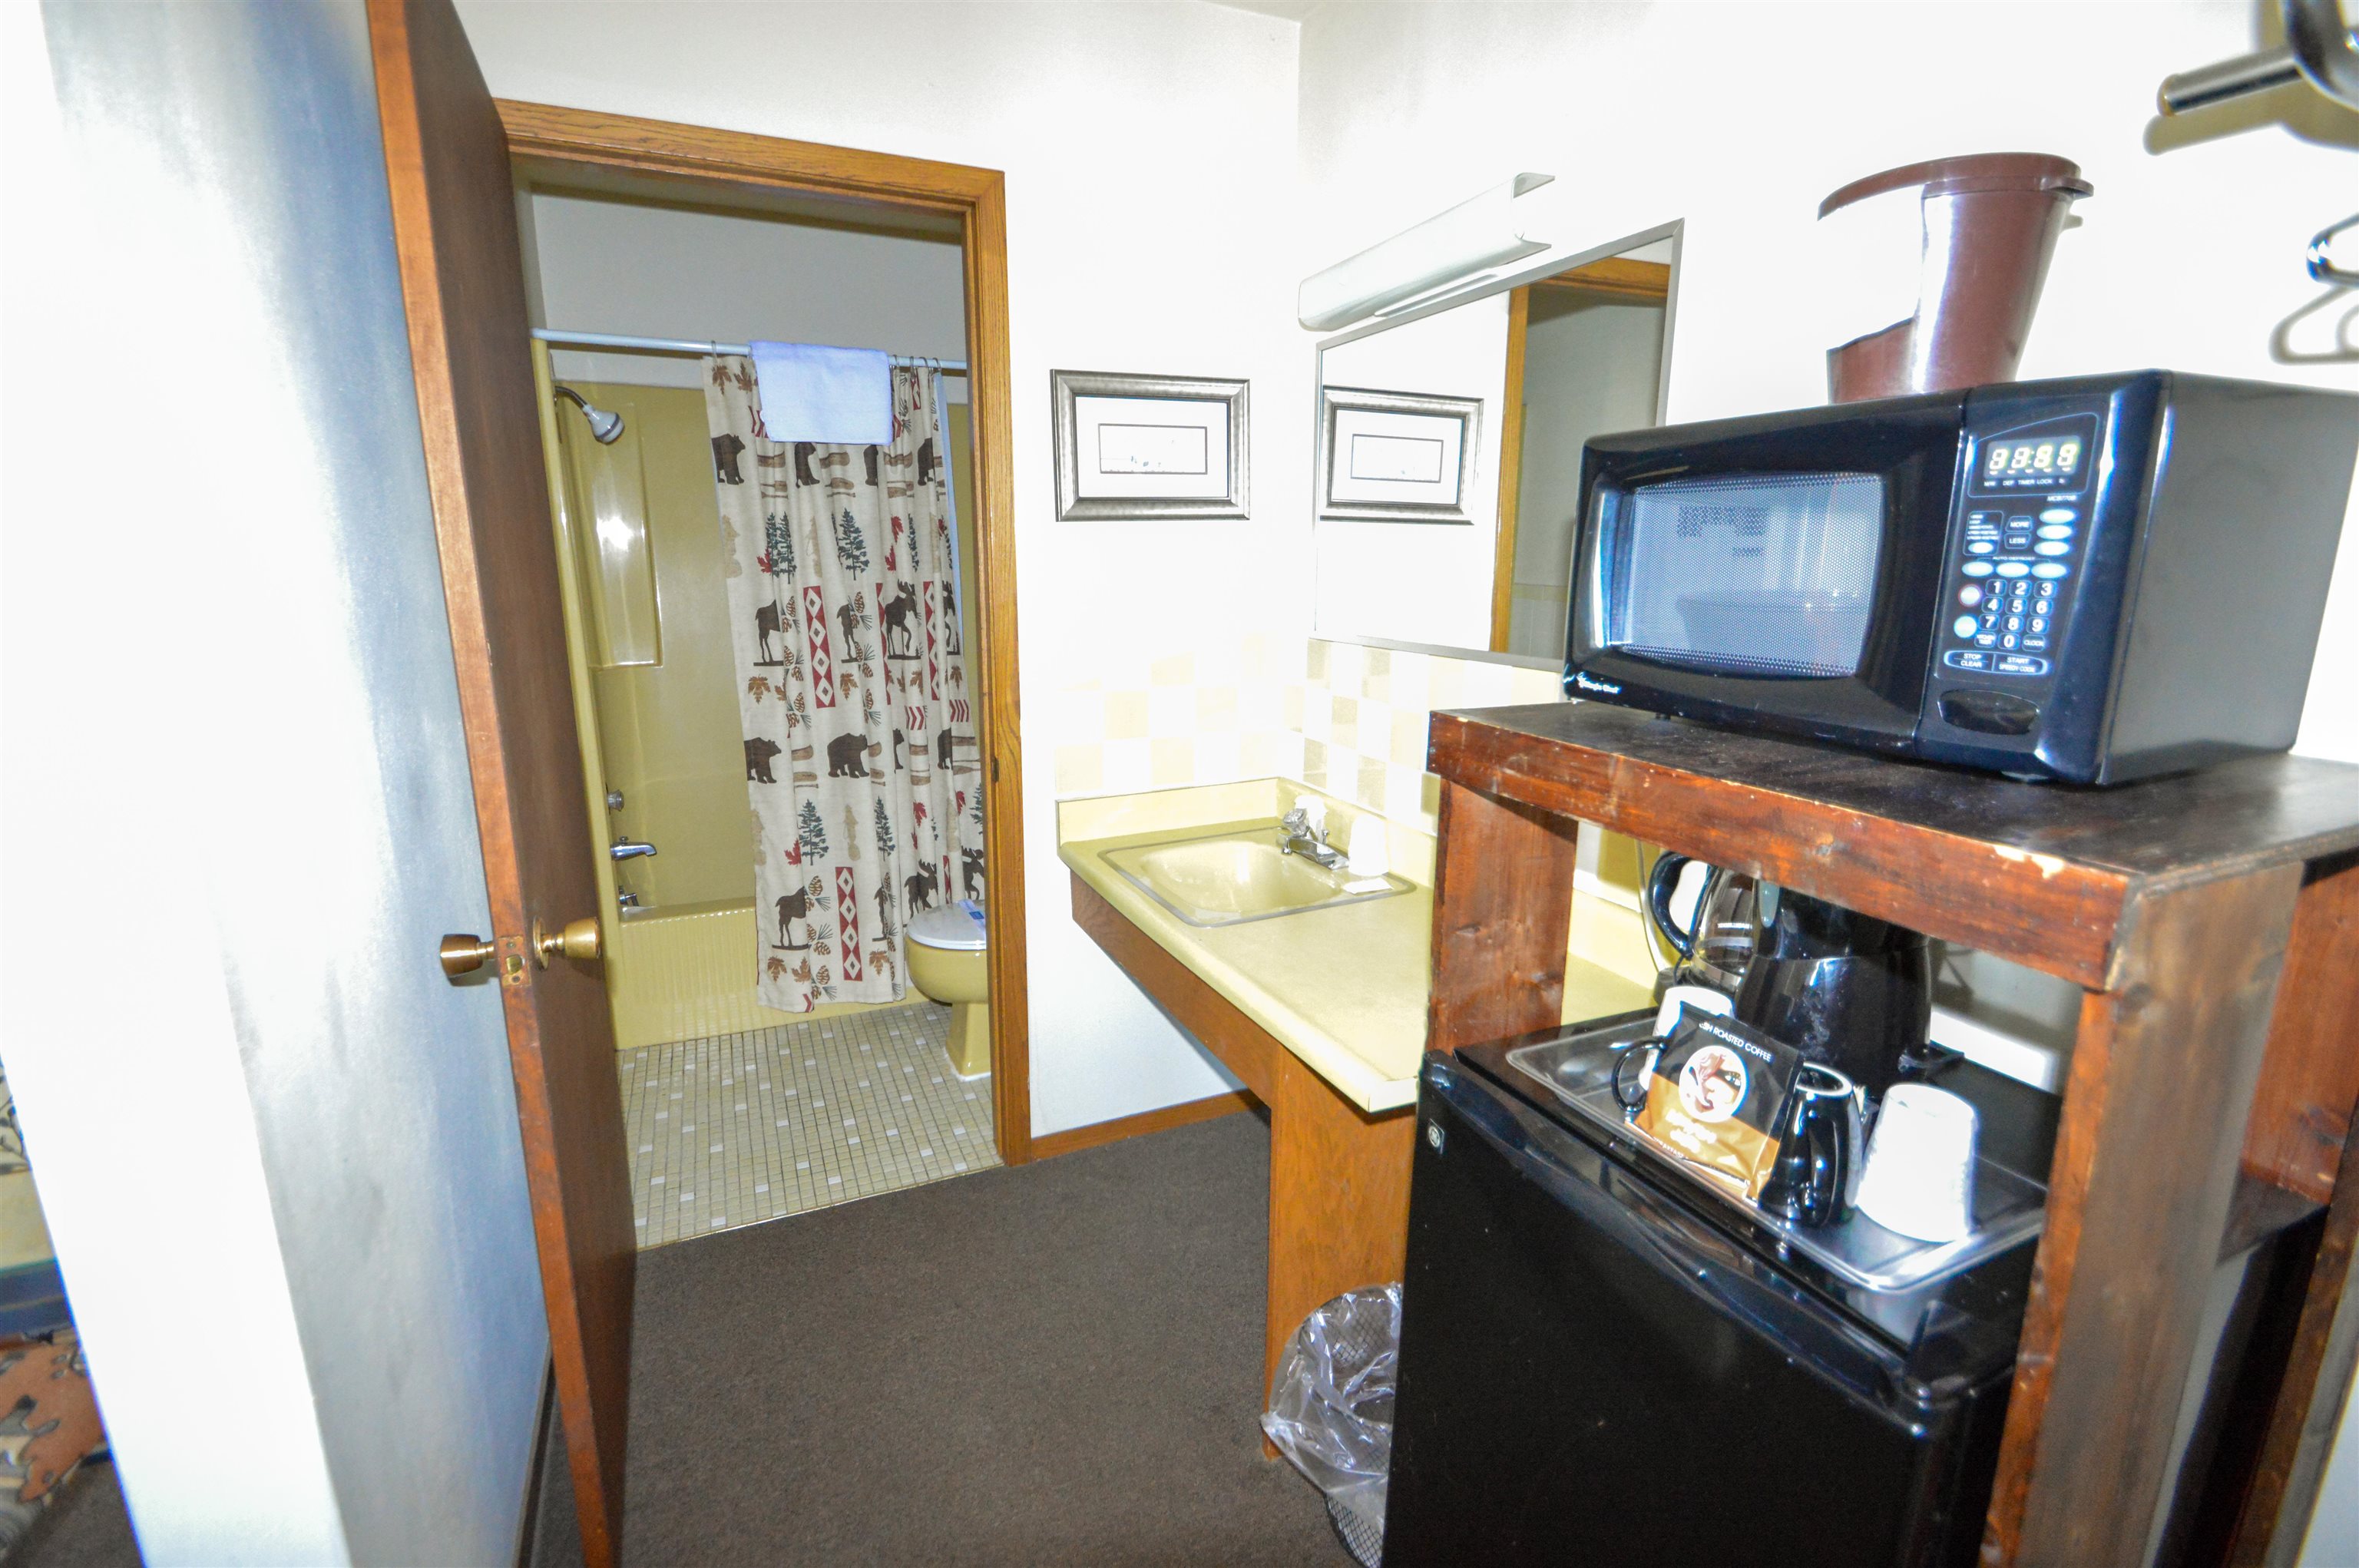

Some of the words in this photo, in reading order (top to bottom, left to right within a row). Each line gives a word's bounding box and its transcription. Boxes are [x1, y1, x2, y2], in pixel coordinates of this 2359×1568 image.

[1993, 581, 2000, 594] 1
[2015, 582, 2026, 595] 2
[2040, 583, 2052, 597] 3
[1987, 599, 1997, 611] 4
[2012, 600, 2023, 613] 5
[2036, 600, 2047, 614] 6
[1985, 616, 1995, 628] 7
[2008, 617, 2019, 630] 8
[2032, 619, 2043, 632] 9
[2003, 635, 2015, 648] 0
[1712, 1027, 1745, 1047] ROASTED
[1745, 1043, 1772, 1063] COFFEE
